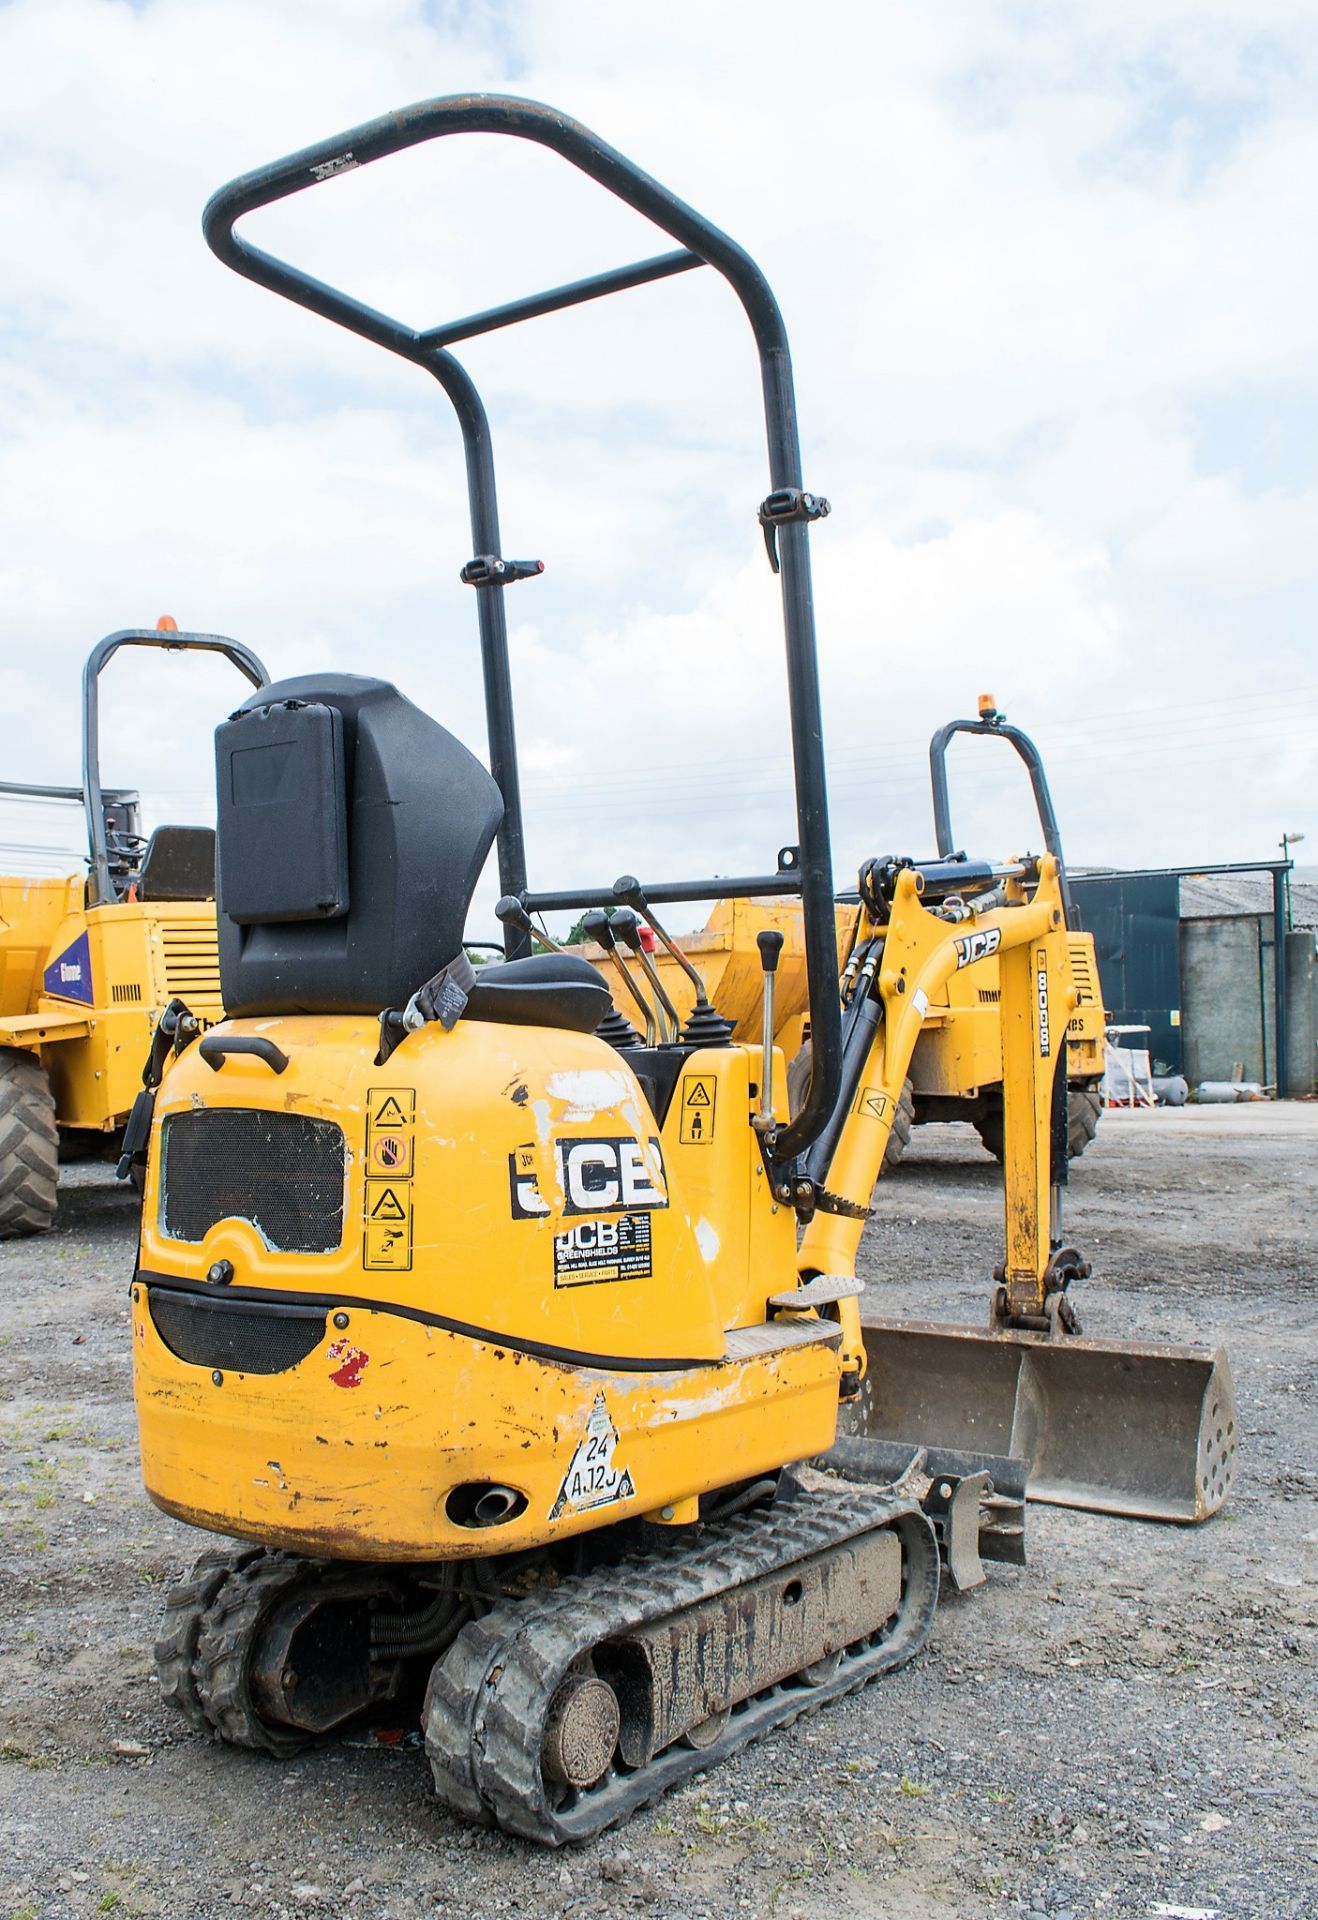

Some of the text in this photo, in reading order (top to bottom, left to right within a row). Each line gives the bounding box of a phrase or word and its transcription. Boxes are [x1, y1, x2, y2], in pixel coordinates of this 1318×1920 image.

[957, 928, 1001, 969] JCB
[556, 1246, 619, 1261] GREENSHIELDS
[586, 1432, 609, 1462] 24
